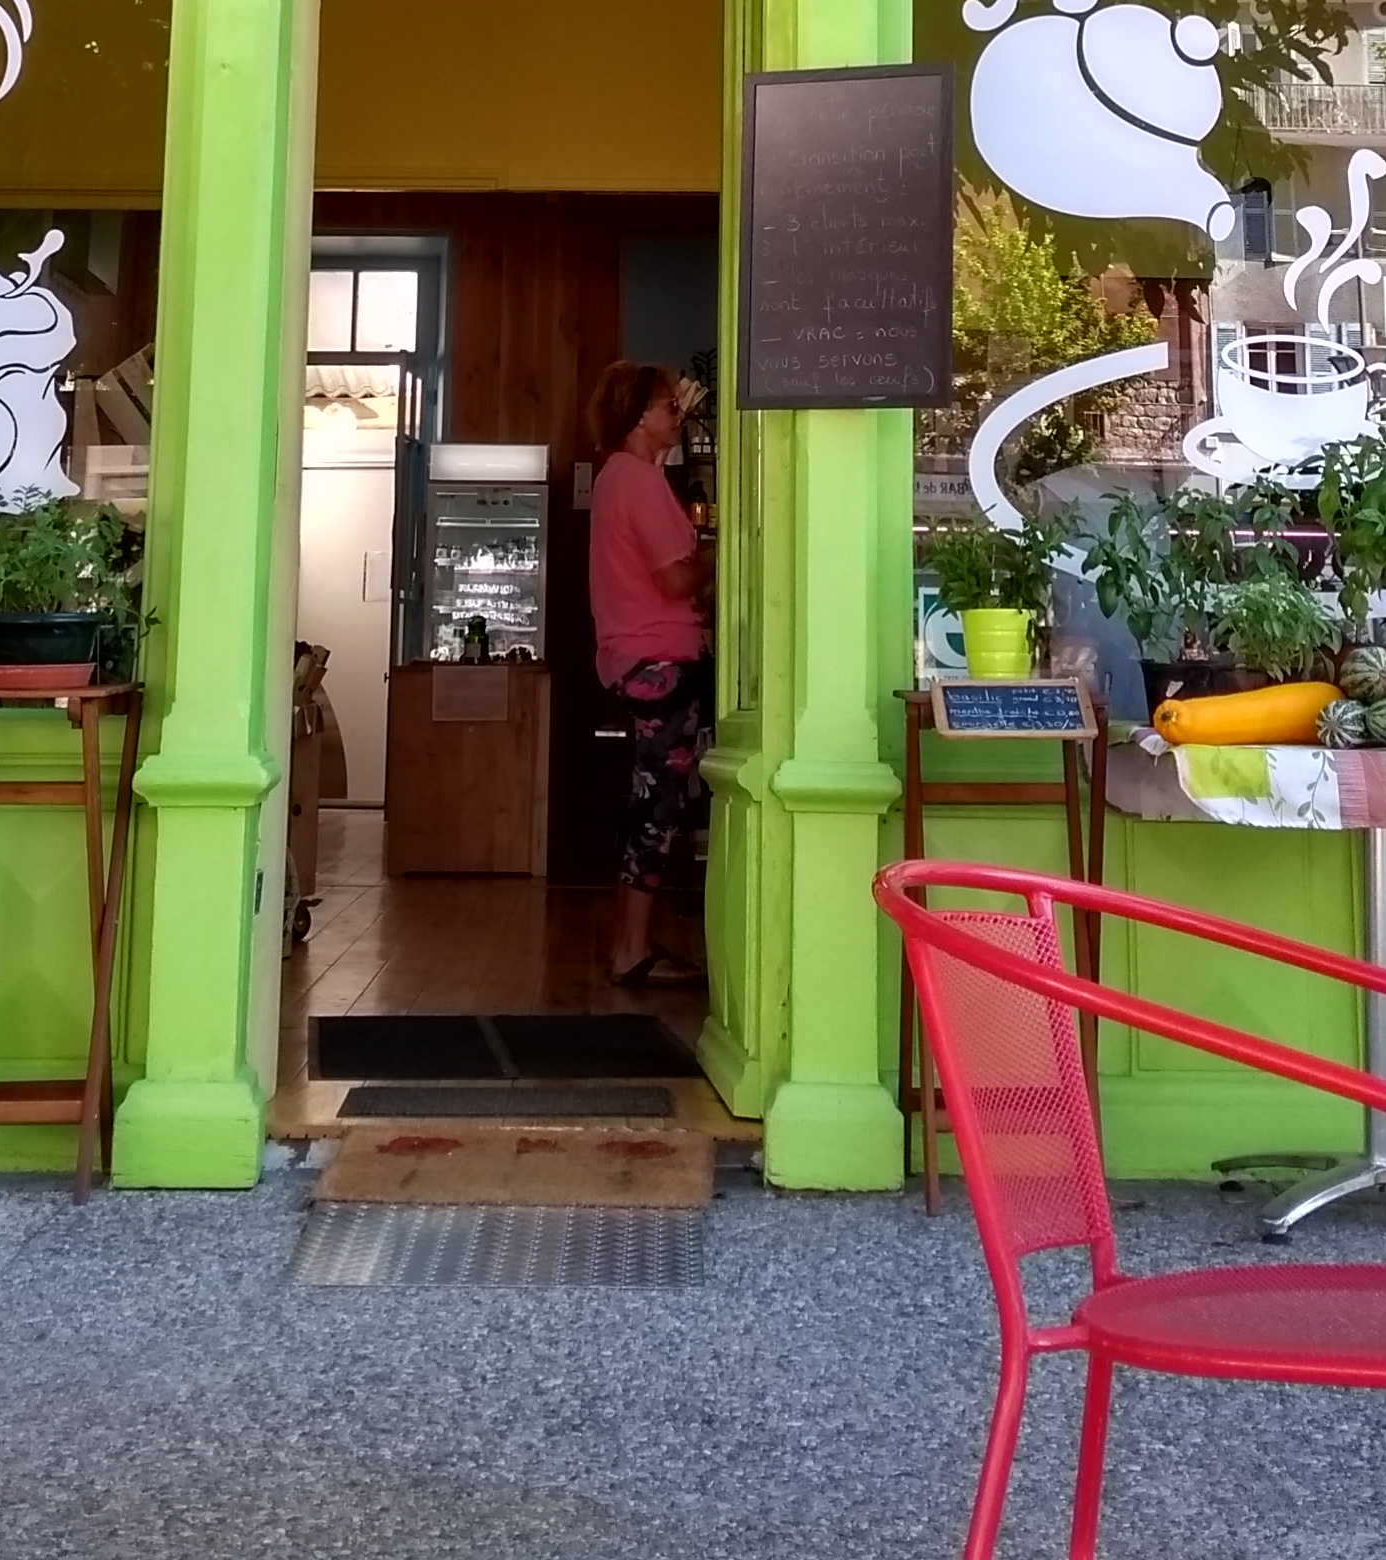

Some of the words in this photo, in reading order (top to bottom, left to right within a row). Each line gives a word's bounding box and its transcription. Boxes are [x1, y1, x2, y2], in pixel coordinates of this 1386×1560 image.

[760, 291, 801, 312] sont
[793, 325, 846, 341] VRAC
[875, 326, 917, 339] nous
[818, 352, 898, 369] servons
